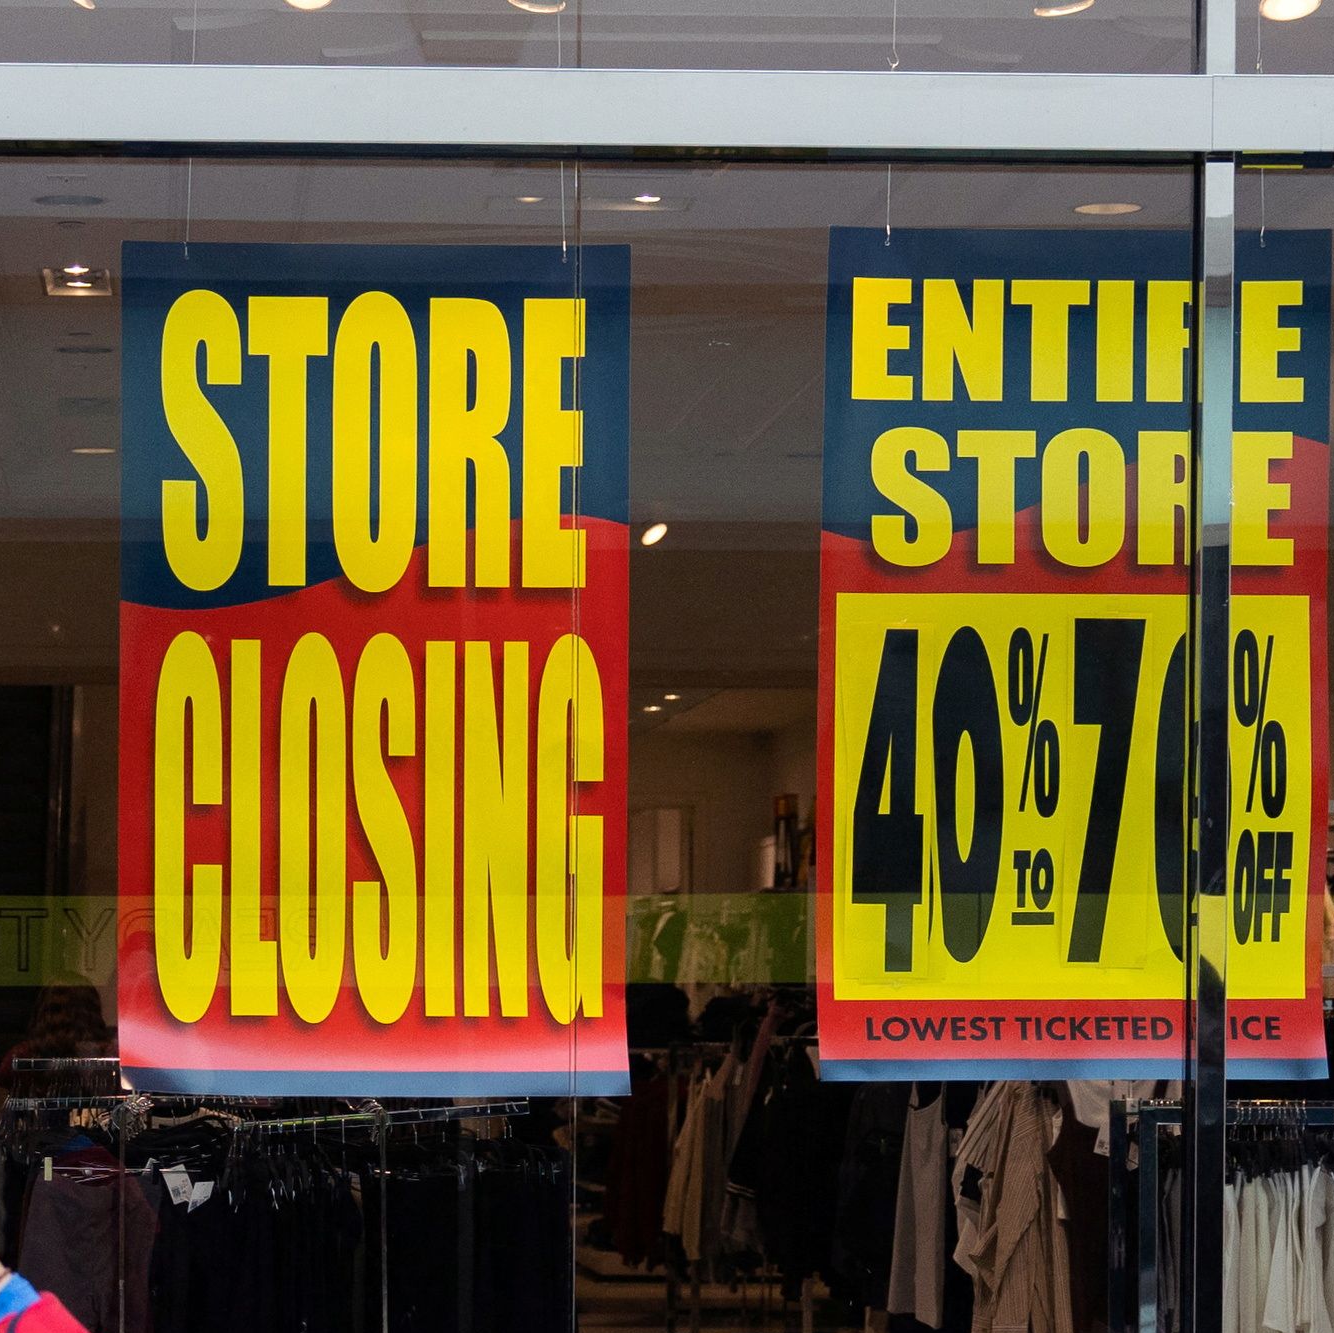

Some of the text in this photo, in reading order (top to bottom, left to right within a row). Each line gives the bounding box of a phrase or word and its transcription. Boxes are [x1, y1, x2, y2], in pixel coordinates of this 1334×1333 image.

[161, 289, 586, 593] STORE
[870, 427, 1294, 568] STORE
[154, 631, 604, 1024] CLOSING
[851, 626, 1060, 972] 40%
[1014, 849, 1054, 911] TO
[1233, 829, 1293, 945] OFF
[865, 1016, 1006, 1042] LOWEST
[1014, 1016, 1174, 1041] TICKETED
